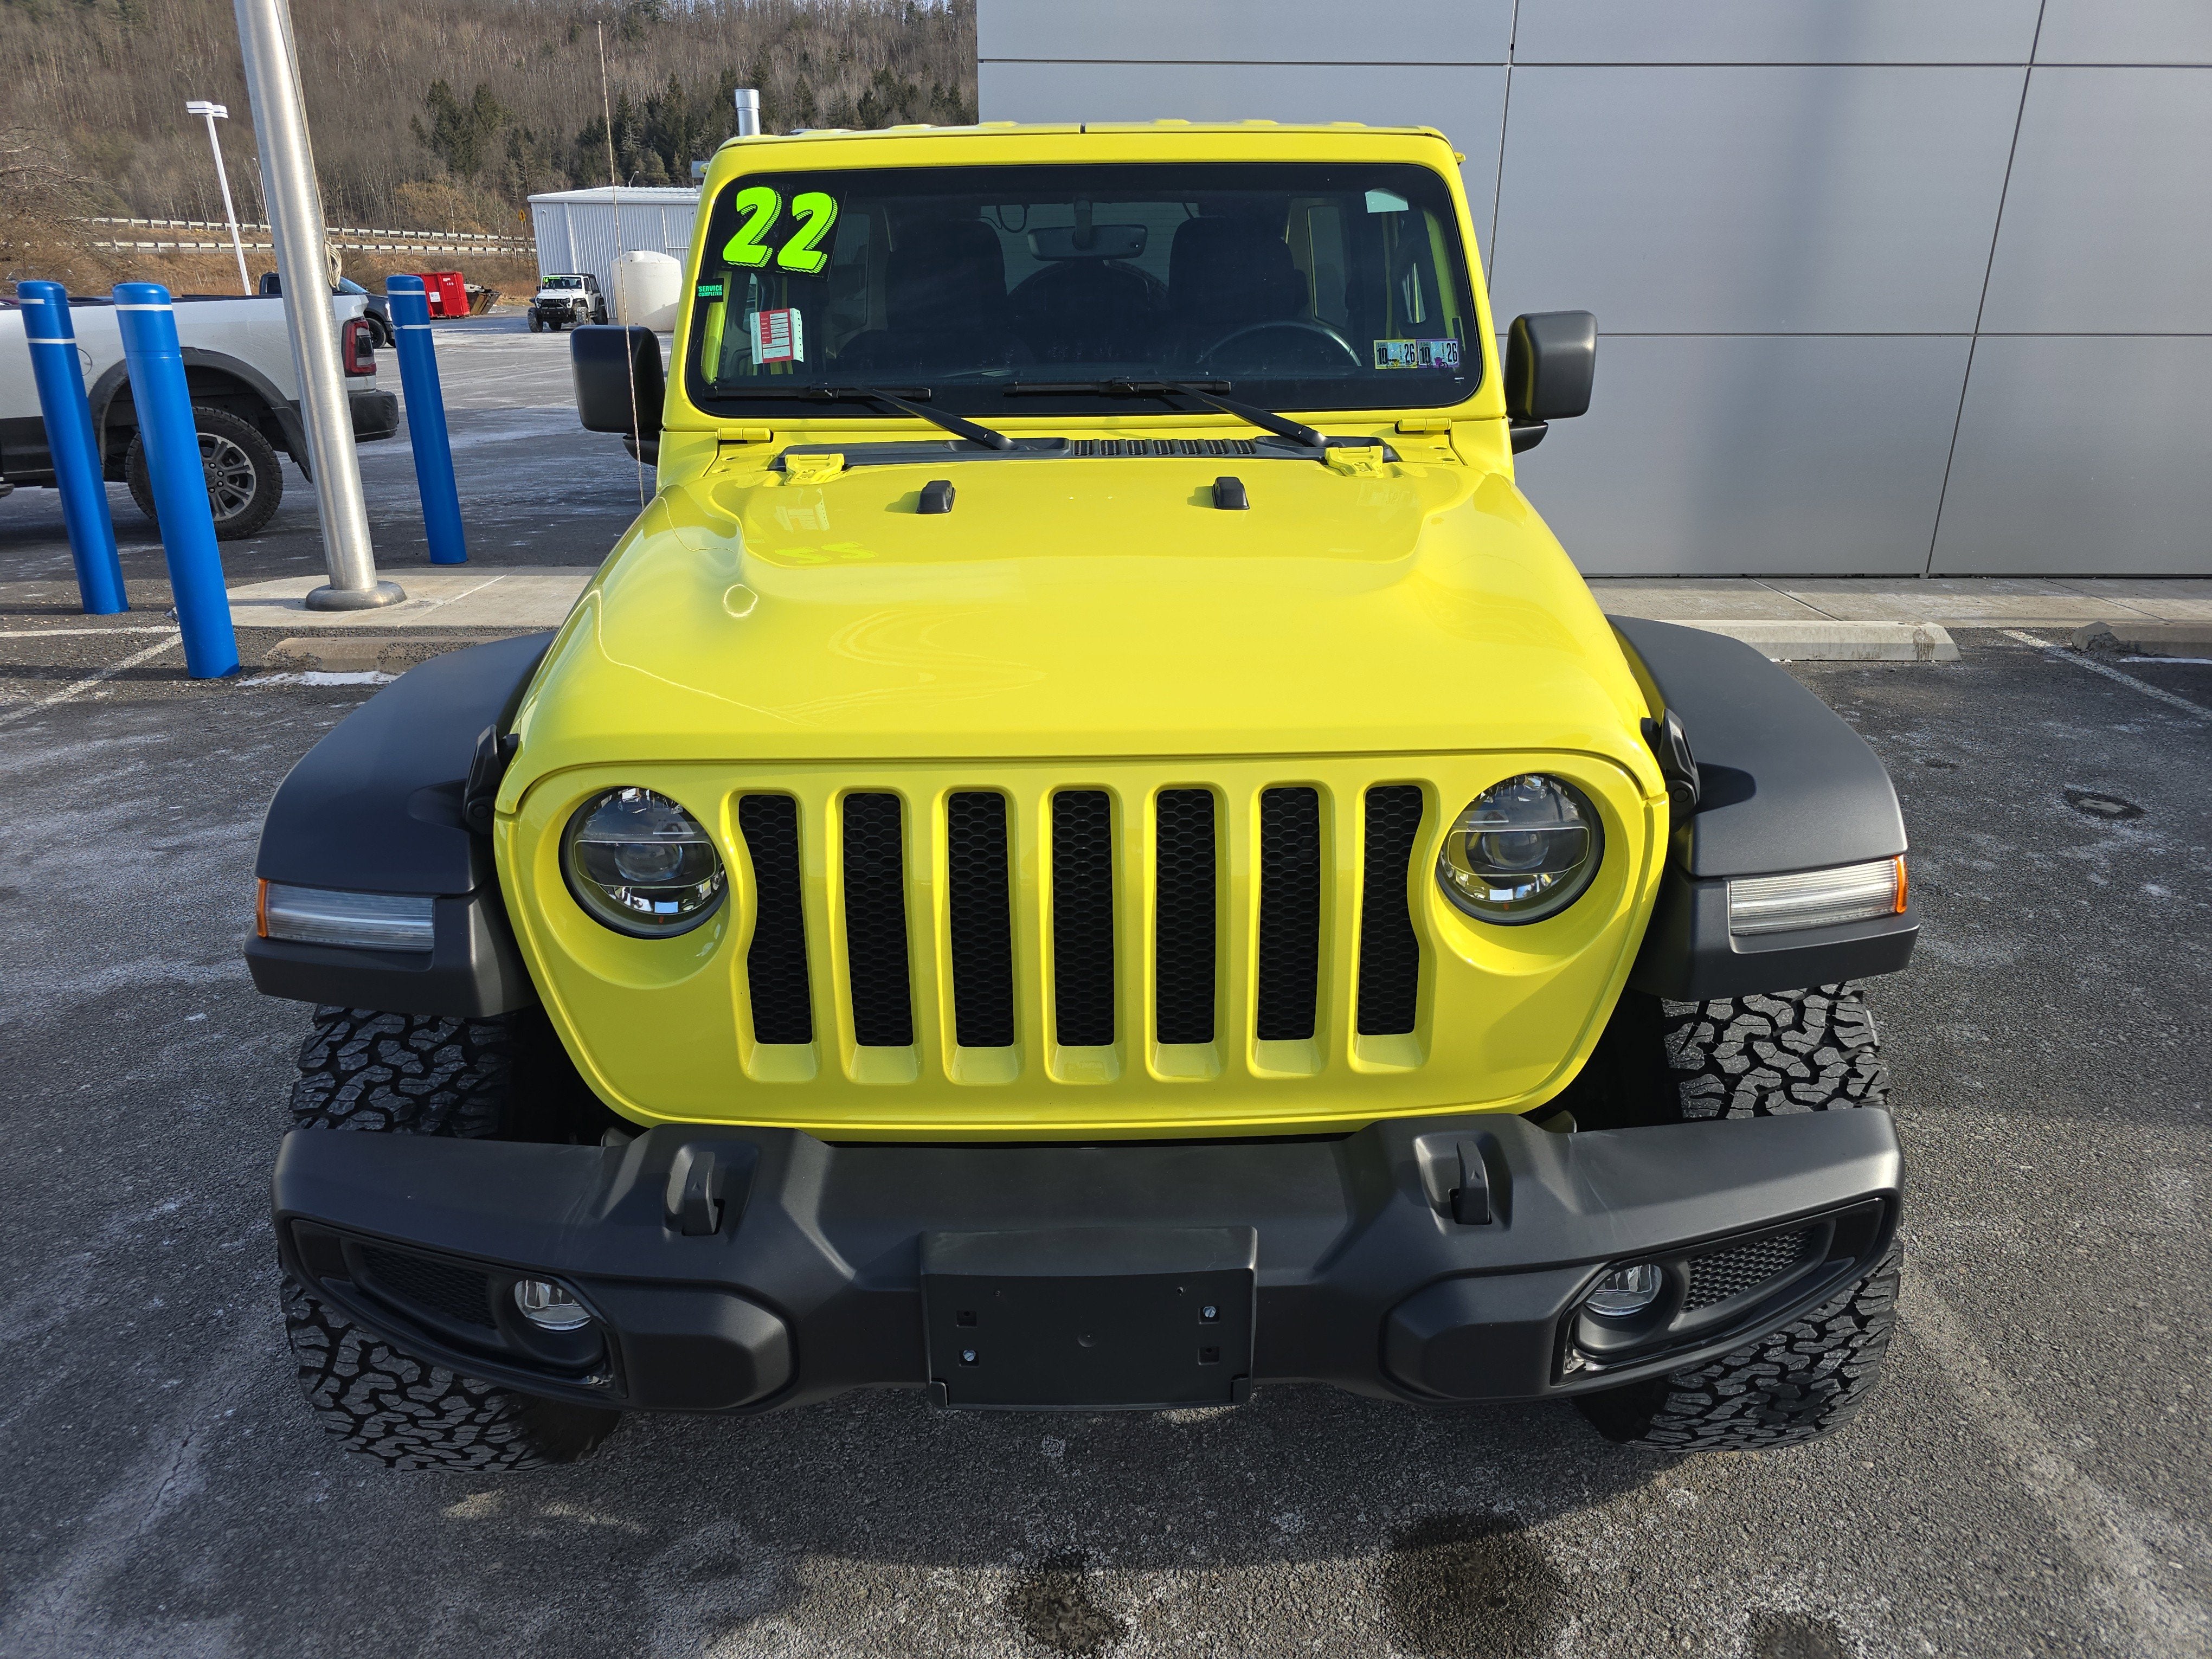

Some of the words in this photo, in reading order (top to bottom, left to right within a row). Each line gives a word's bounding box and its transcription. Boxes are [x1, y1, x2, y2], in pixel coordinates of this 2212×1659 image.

[723, 187, 838, 274] 22
[1404, 343, 1415, 363] 26
[1446, 343, 1458, 362] 26
